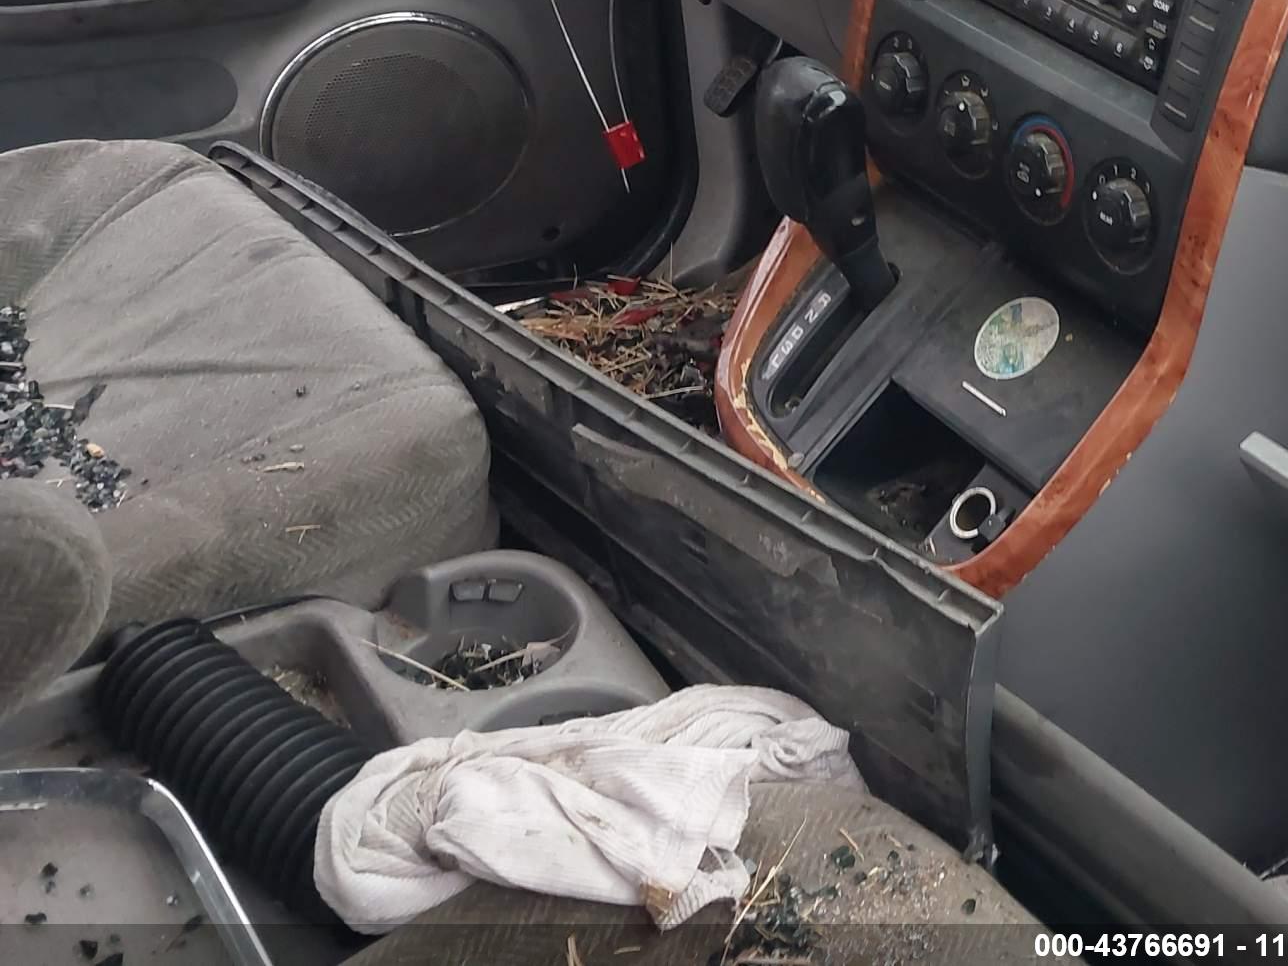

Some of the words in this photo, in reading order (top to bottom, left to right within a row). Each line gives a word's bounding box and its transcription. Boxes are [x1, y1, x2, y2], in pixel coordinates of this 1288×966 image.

[1092, 30, 1099, 41] 5
[1116, 42, 1123, 53] 6
[818, 293, 831, 307] R
[804, 309, 818, 323] N
[791, 325, 804, 340] D
